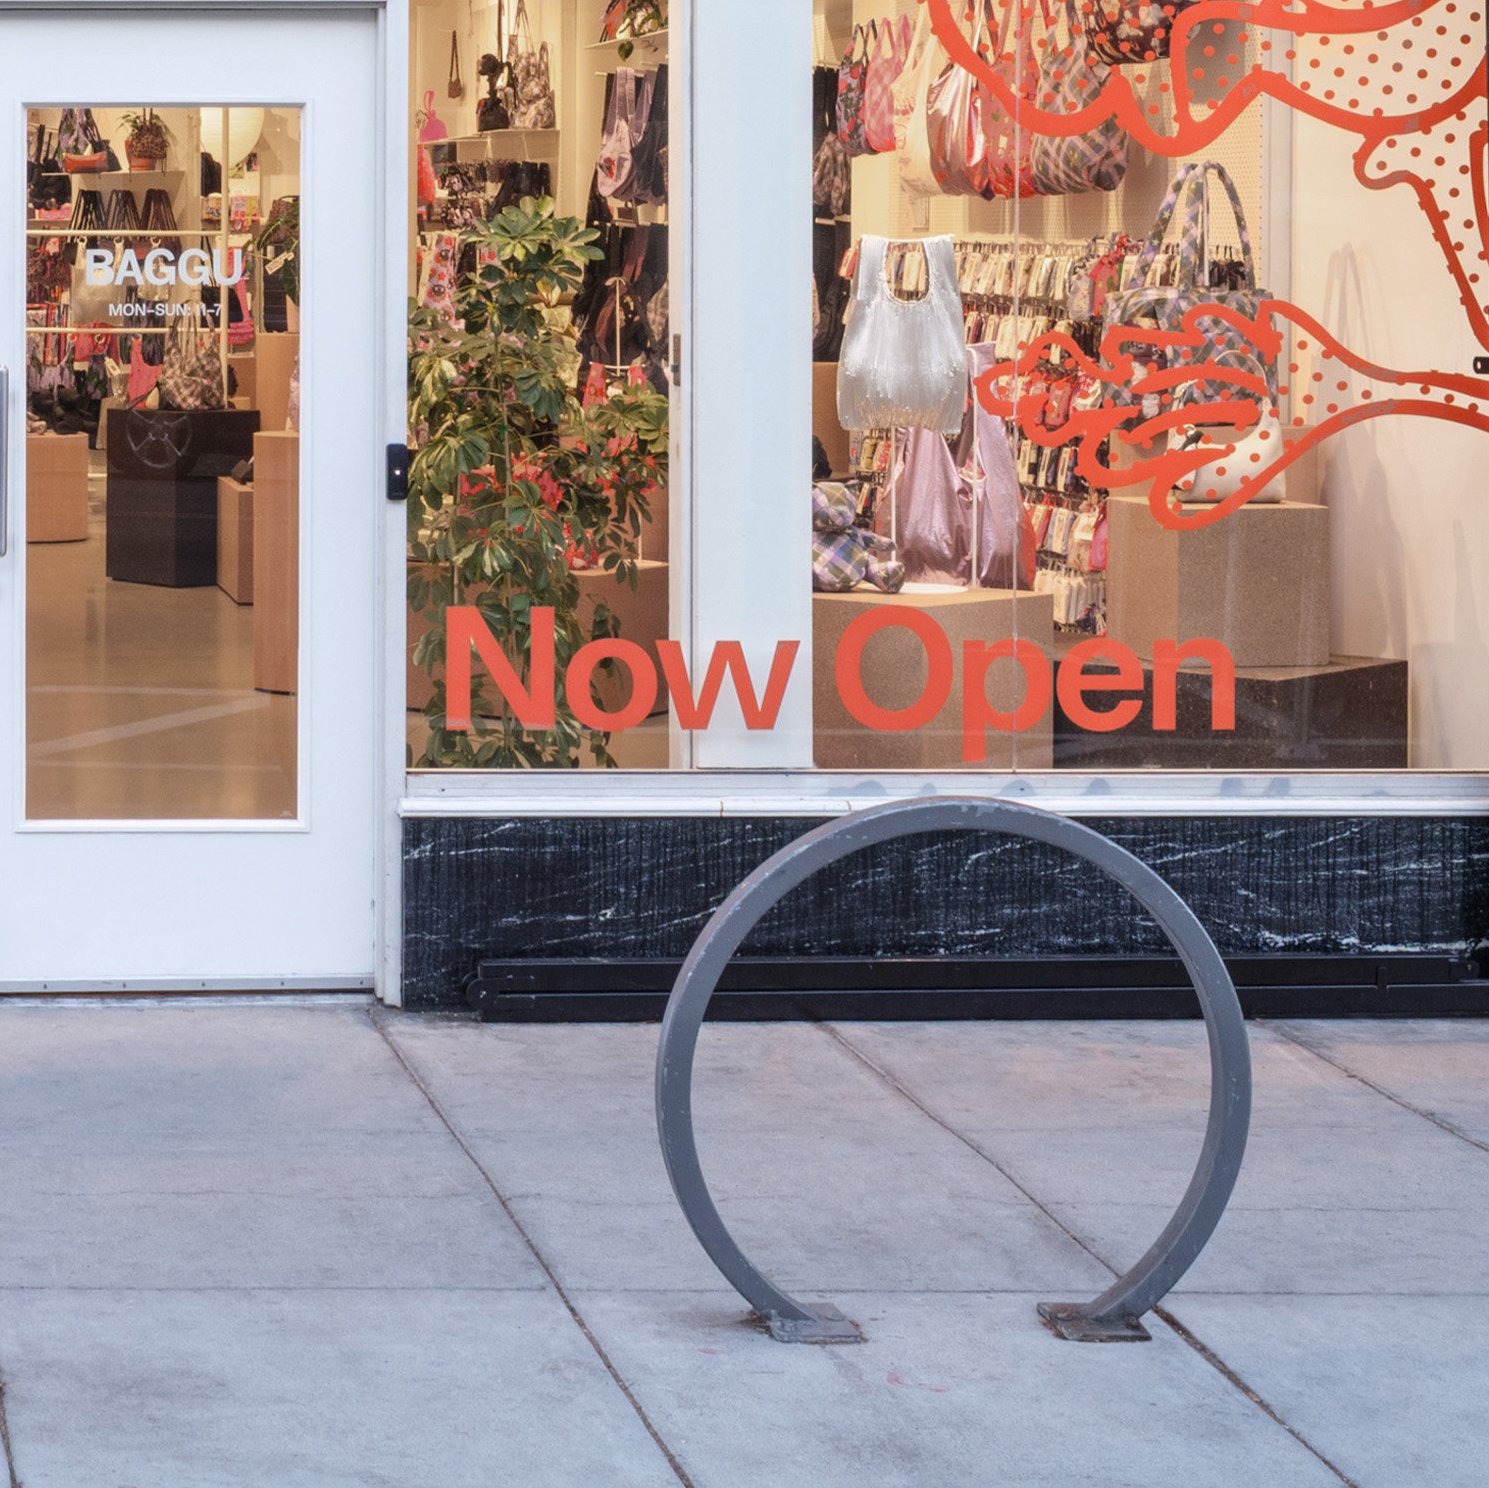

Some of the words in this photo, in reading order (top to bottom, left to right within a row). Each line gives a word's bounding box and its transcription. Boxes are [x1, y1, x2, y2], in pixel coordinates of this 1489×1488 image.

[85, 248, 243, 286] BAGGU
[446, 606, 800, 732] Now
[834, 606, 1236, 761] Open
